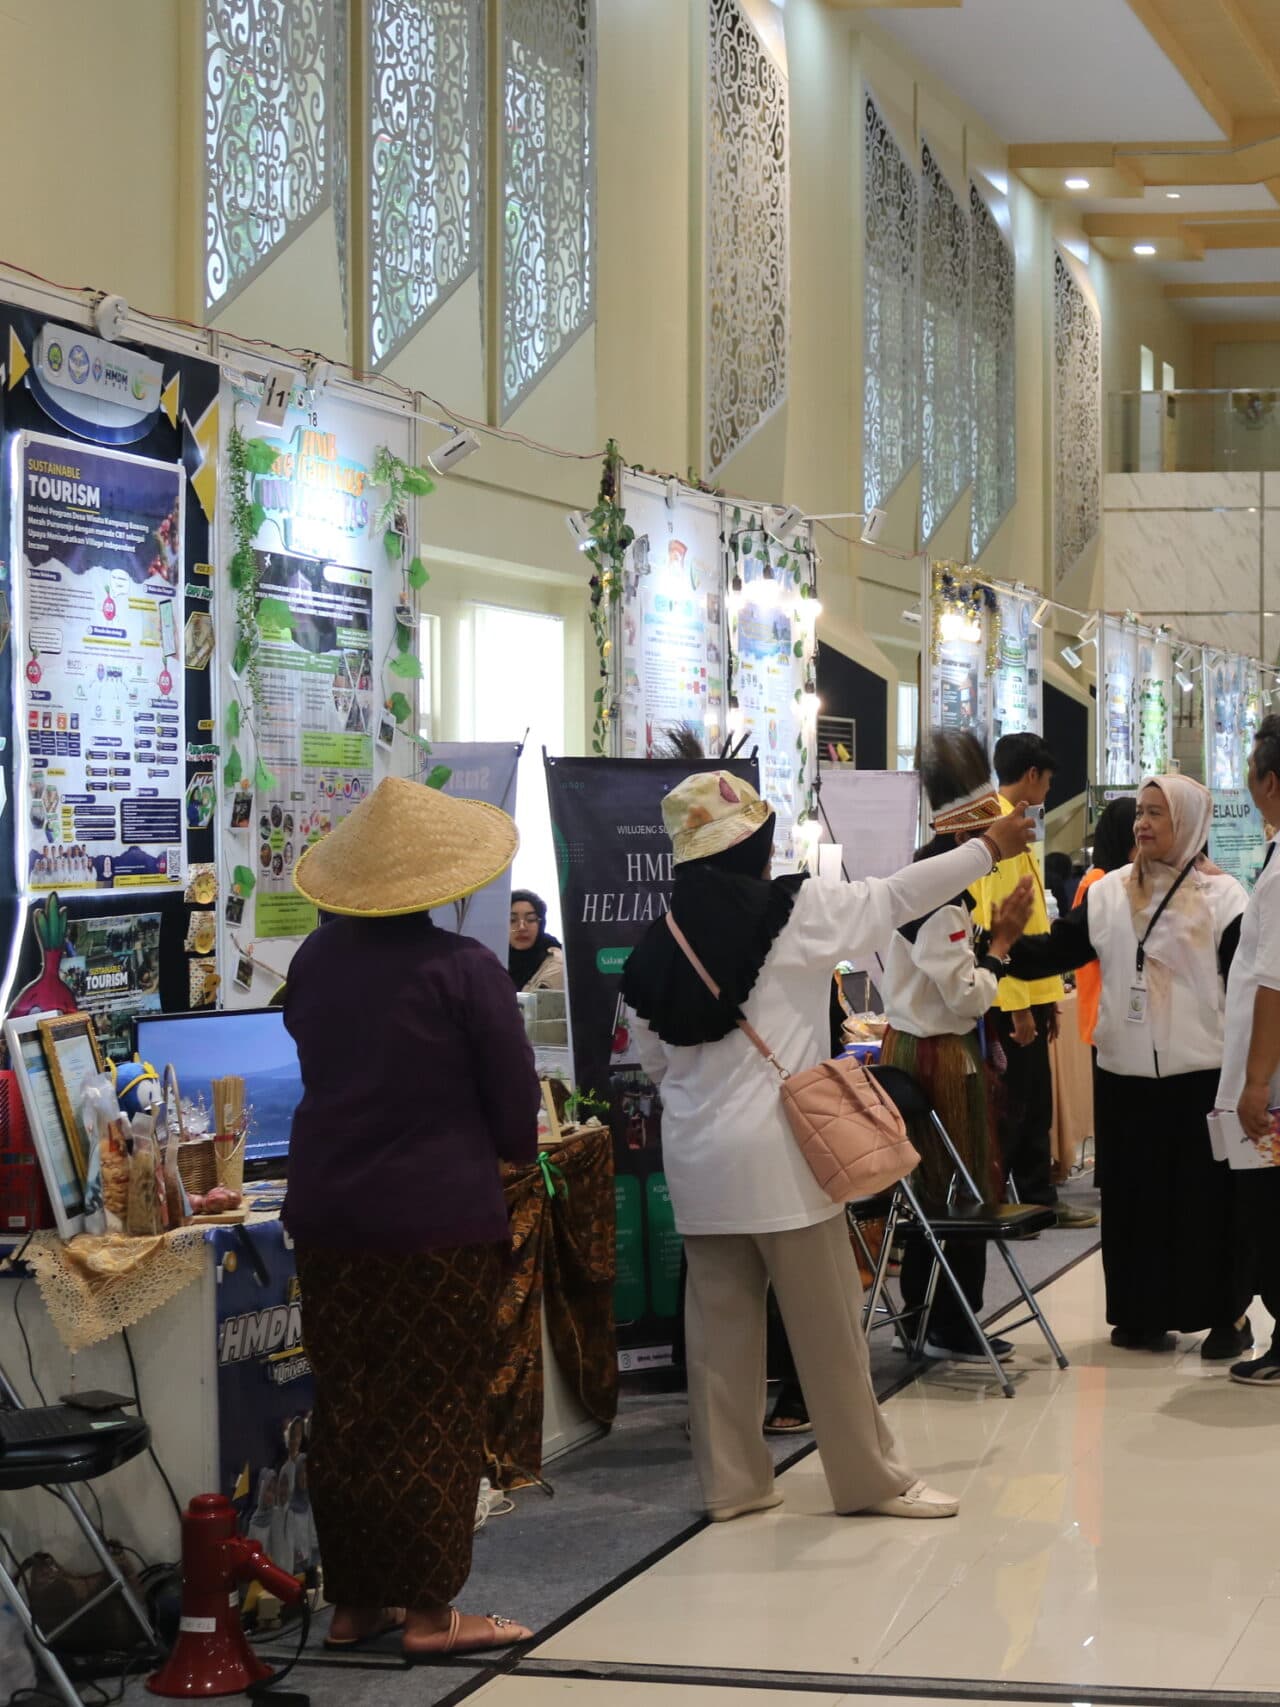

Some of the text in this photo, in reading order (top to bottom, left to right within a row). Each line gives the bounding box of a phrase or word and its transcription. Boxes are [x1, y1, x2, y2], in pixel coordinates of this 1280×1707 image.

[307, 411, 318, 428] 18
[28, 459, 81, 480] SUSTAINABLE
[28, 475, 100, 509] TOURISM
[582, 892, 673, 923] HELIAN
[86, 972, 128, 990] TOURISM
